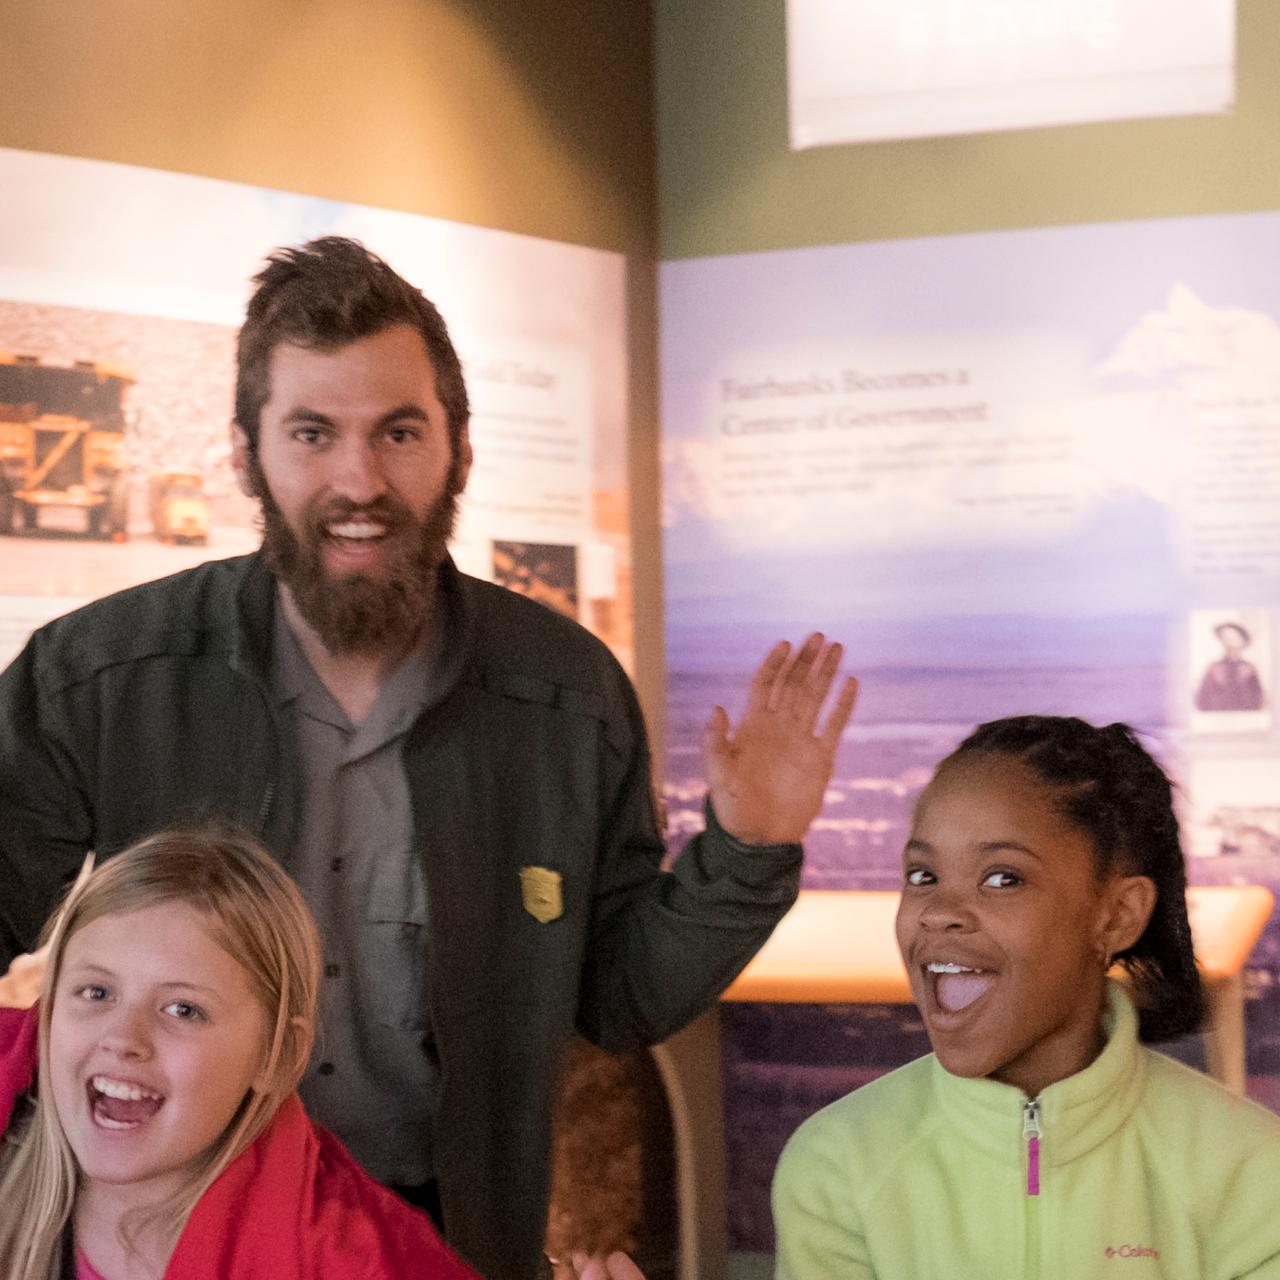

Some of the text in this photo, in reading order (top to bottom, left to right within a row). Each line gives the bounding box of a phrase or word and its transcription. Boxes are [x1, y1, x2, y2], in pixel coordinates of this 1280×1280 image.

[721, 371, 834, 402] Fairbanks
[839, 367, 950, 393] Becomes
[720, 413, 797, 437] Center
[834, 400, 989, 430] Government
